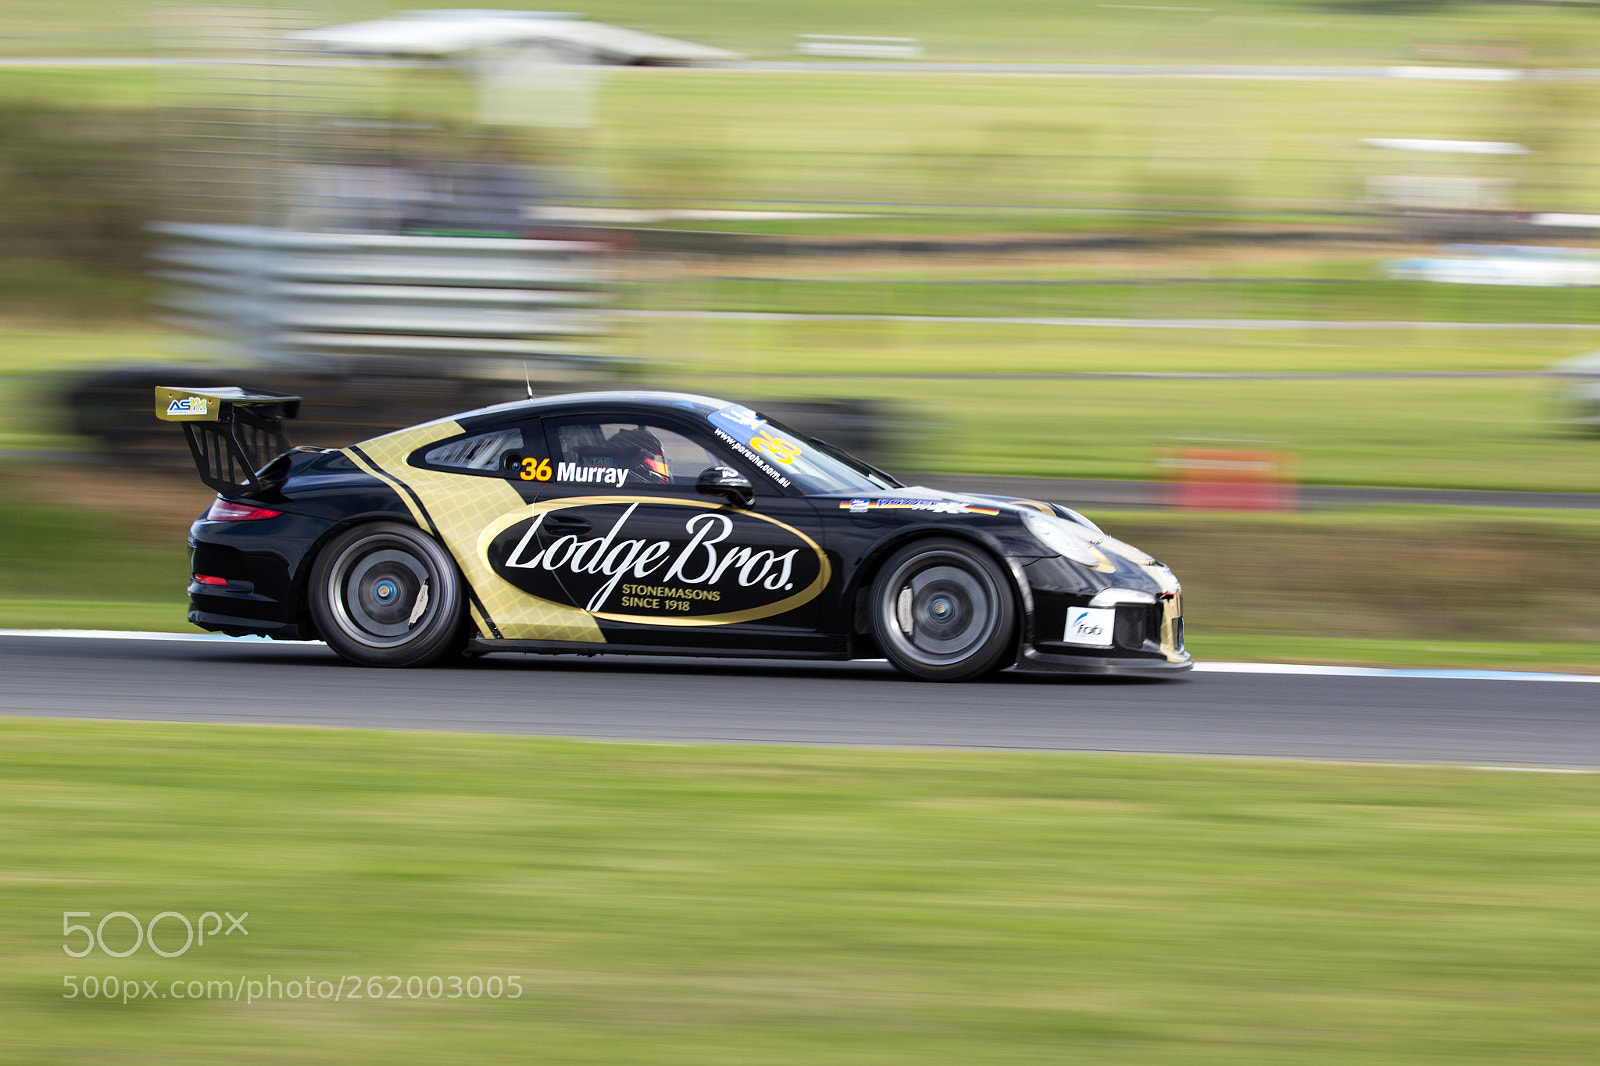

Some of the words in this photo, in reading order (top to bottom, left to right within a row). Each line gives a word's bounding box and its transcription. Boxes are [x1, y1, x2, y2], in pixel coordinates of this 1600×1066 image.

[520, 457, 553, 482] 36
[557, 462, 629, 488] Murray
[505, 502, 671, 613] Lodge
[663, 513, 800, 591] Bros.
[621, 596, 661, 609] SINCE
[664, 600, 691, 612] 1918
[622, 583, 721, 602] STONEMASONS
